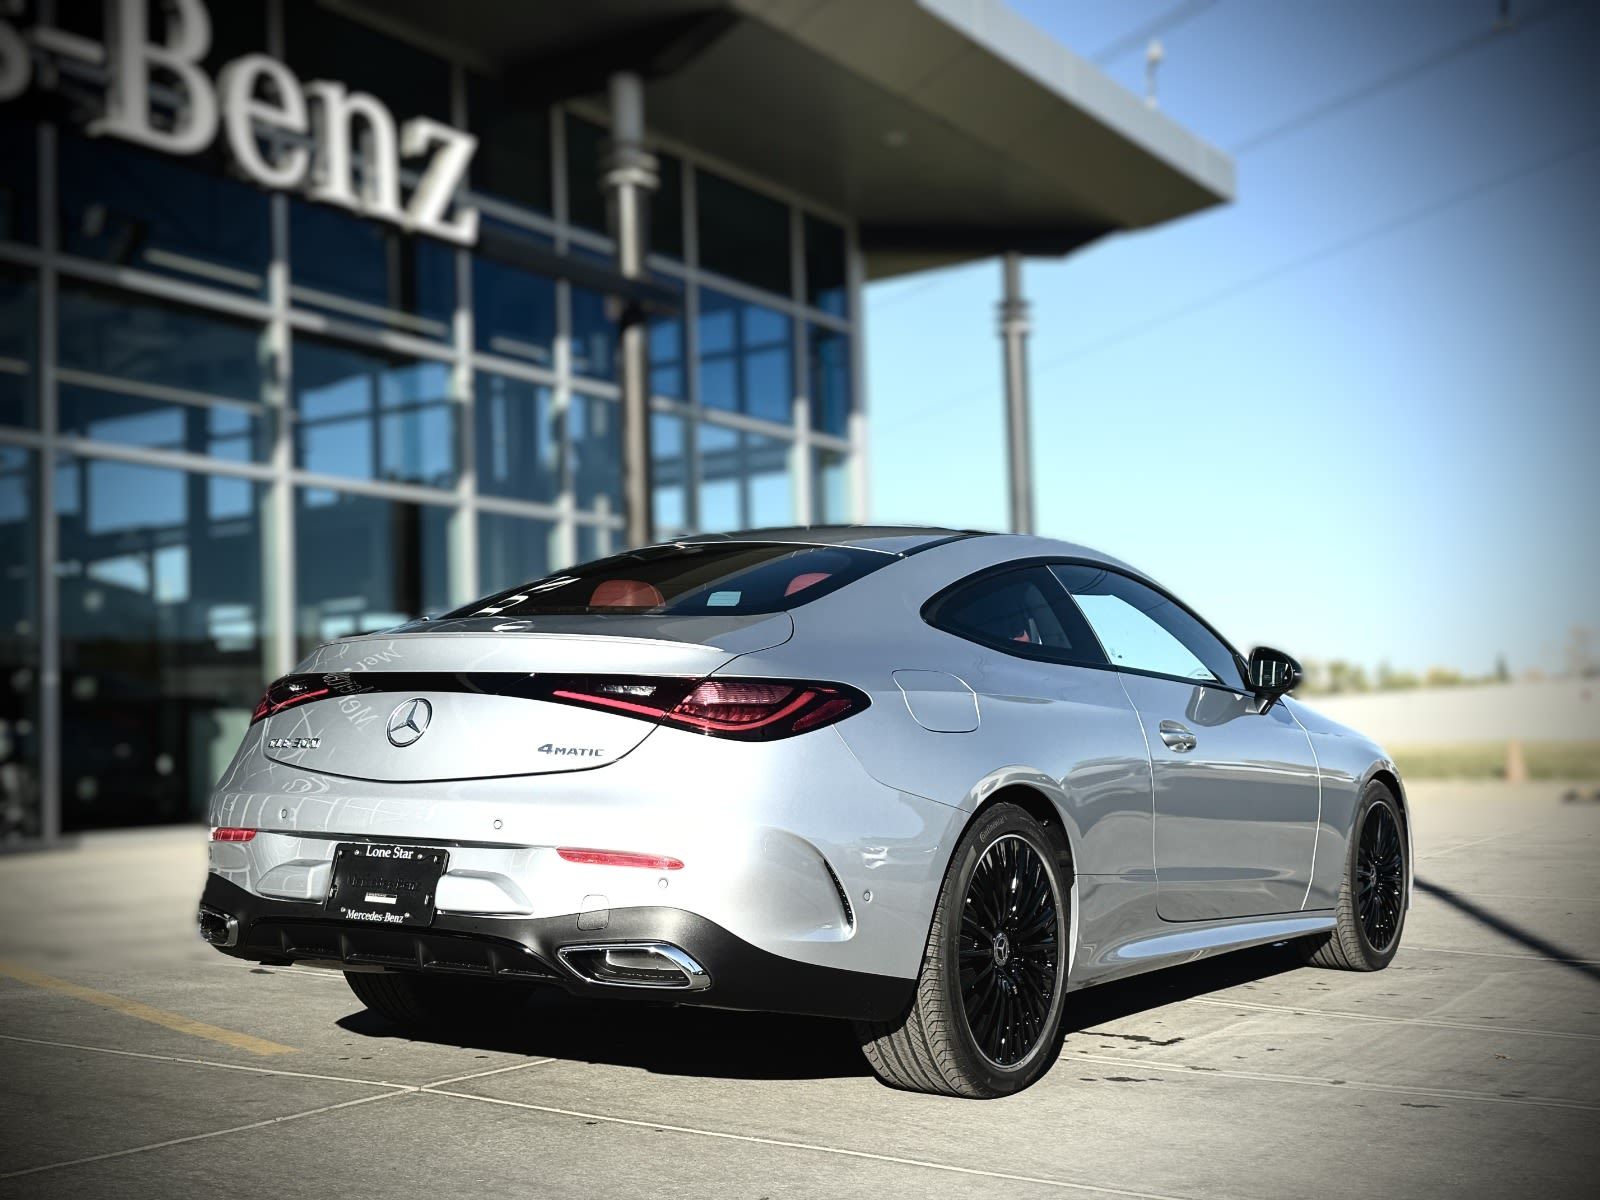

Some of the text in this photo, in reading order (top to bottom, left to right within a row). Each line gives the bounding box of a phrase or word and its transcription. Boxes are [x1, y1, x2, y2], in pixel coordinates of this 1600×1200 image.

[537, 743, 606, 757] 4MATIC
[365, 845, 415, 860] Lone Star
[345, 908, 404, 924] Mercedes-Benz
